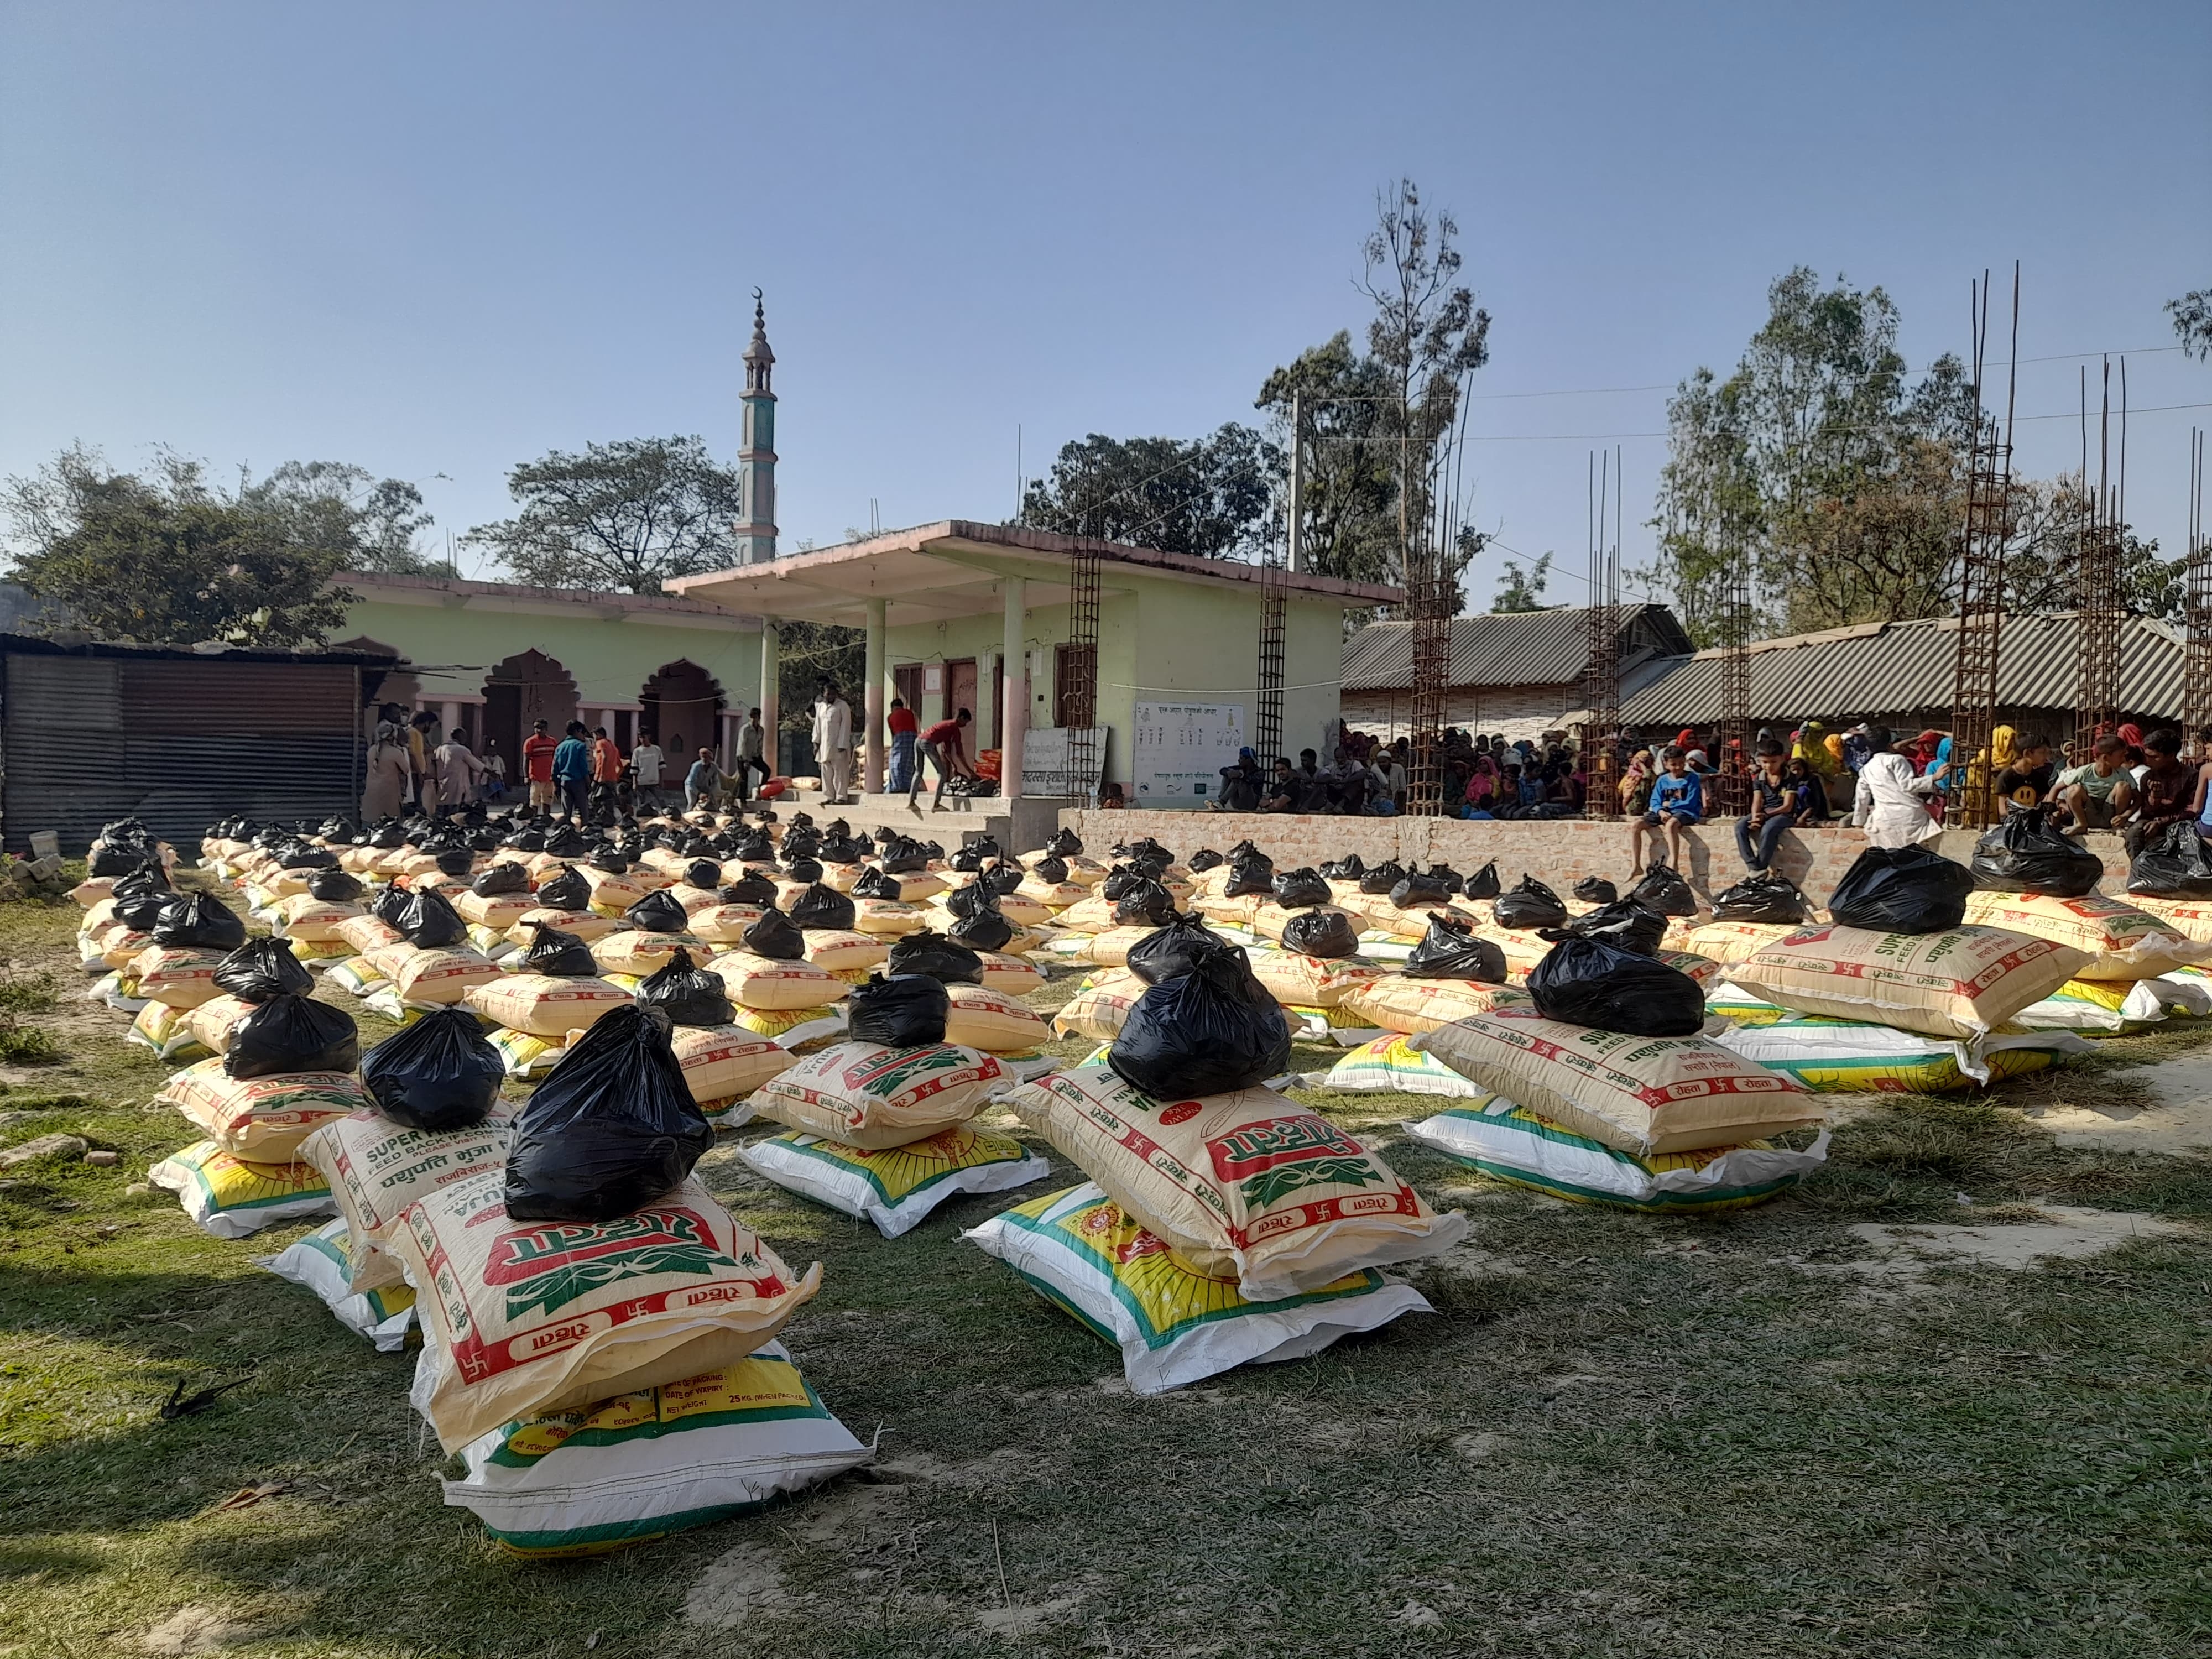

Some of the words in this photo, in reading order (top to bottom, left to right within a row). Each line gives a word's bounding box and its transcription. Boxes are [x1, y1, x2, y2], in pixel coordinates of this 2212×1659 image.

[1897, 941, 1914, 963] FEED
[1924, 935, 1962, 963] पशुपति
[736, 1045, 758, 1054] रोहता
[1596, 1037, 1625, 1055] FEED
[1624, 1041, 1679, 1062] पशुपति
[1055, 1082, 1084, 1104] खुकुरी
[1675, 1084, 1702, 1095] रोहता
[1744, 1079, 1772, 1088] रोहता
[1089, 1107, 1119, 1132] खुकुरी
[366, 1130, 424, 1163] SUPER
[468, 1119, 509, 1130] BHUJ
[413, 1142, 452, 1158] PLEASE
[454, 1136, 478, 1145] VISIT
[368, 1151, 402, 1175] FEED
[405, 1137, 446, 1154] BACK
[380, 1154, 448, 1188] पशुपति
[454, 1144, 493, 1164] भुजा
[1155, 1156, 1188, 1183] खुकुरी
[1353, 1198, 1389, 1211] रोहता
[1258, 1215, 1294, 1234] रोहता
[687, 1286, 742, 1306] रोहता
[532, 1323, 591, 1350] रोहता
[666, 1390, 684, 1399] DATE
[685, 1390, 694, 1399] OF
[695, 1385, 723, 1394] WXPIRY
[681, 1399, 707, 1411] WEIGHT
